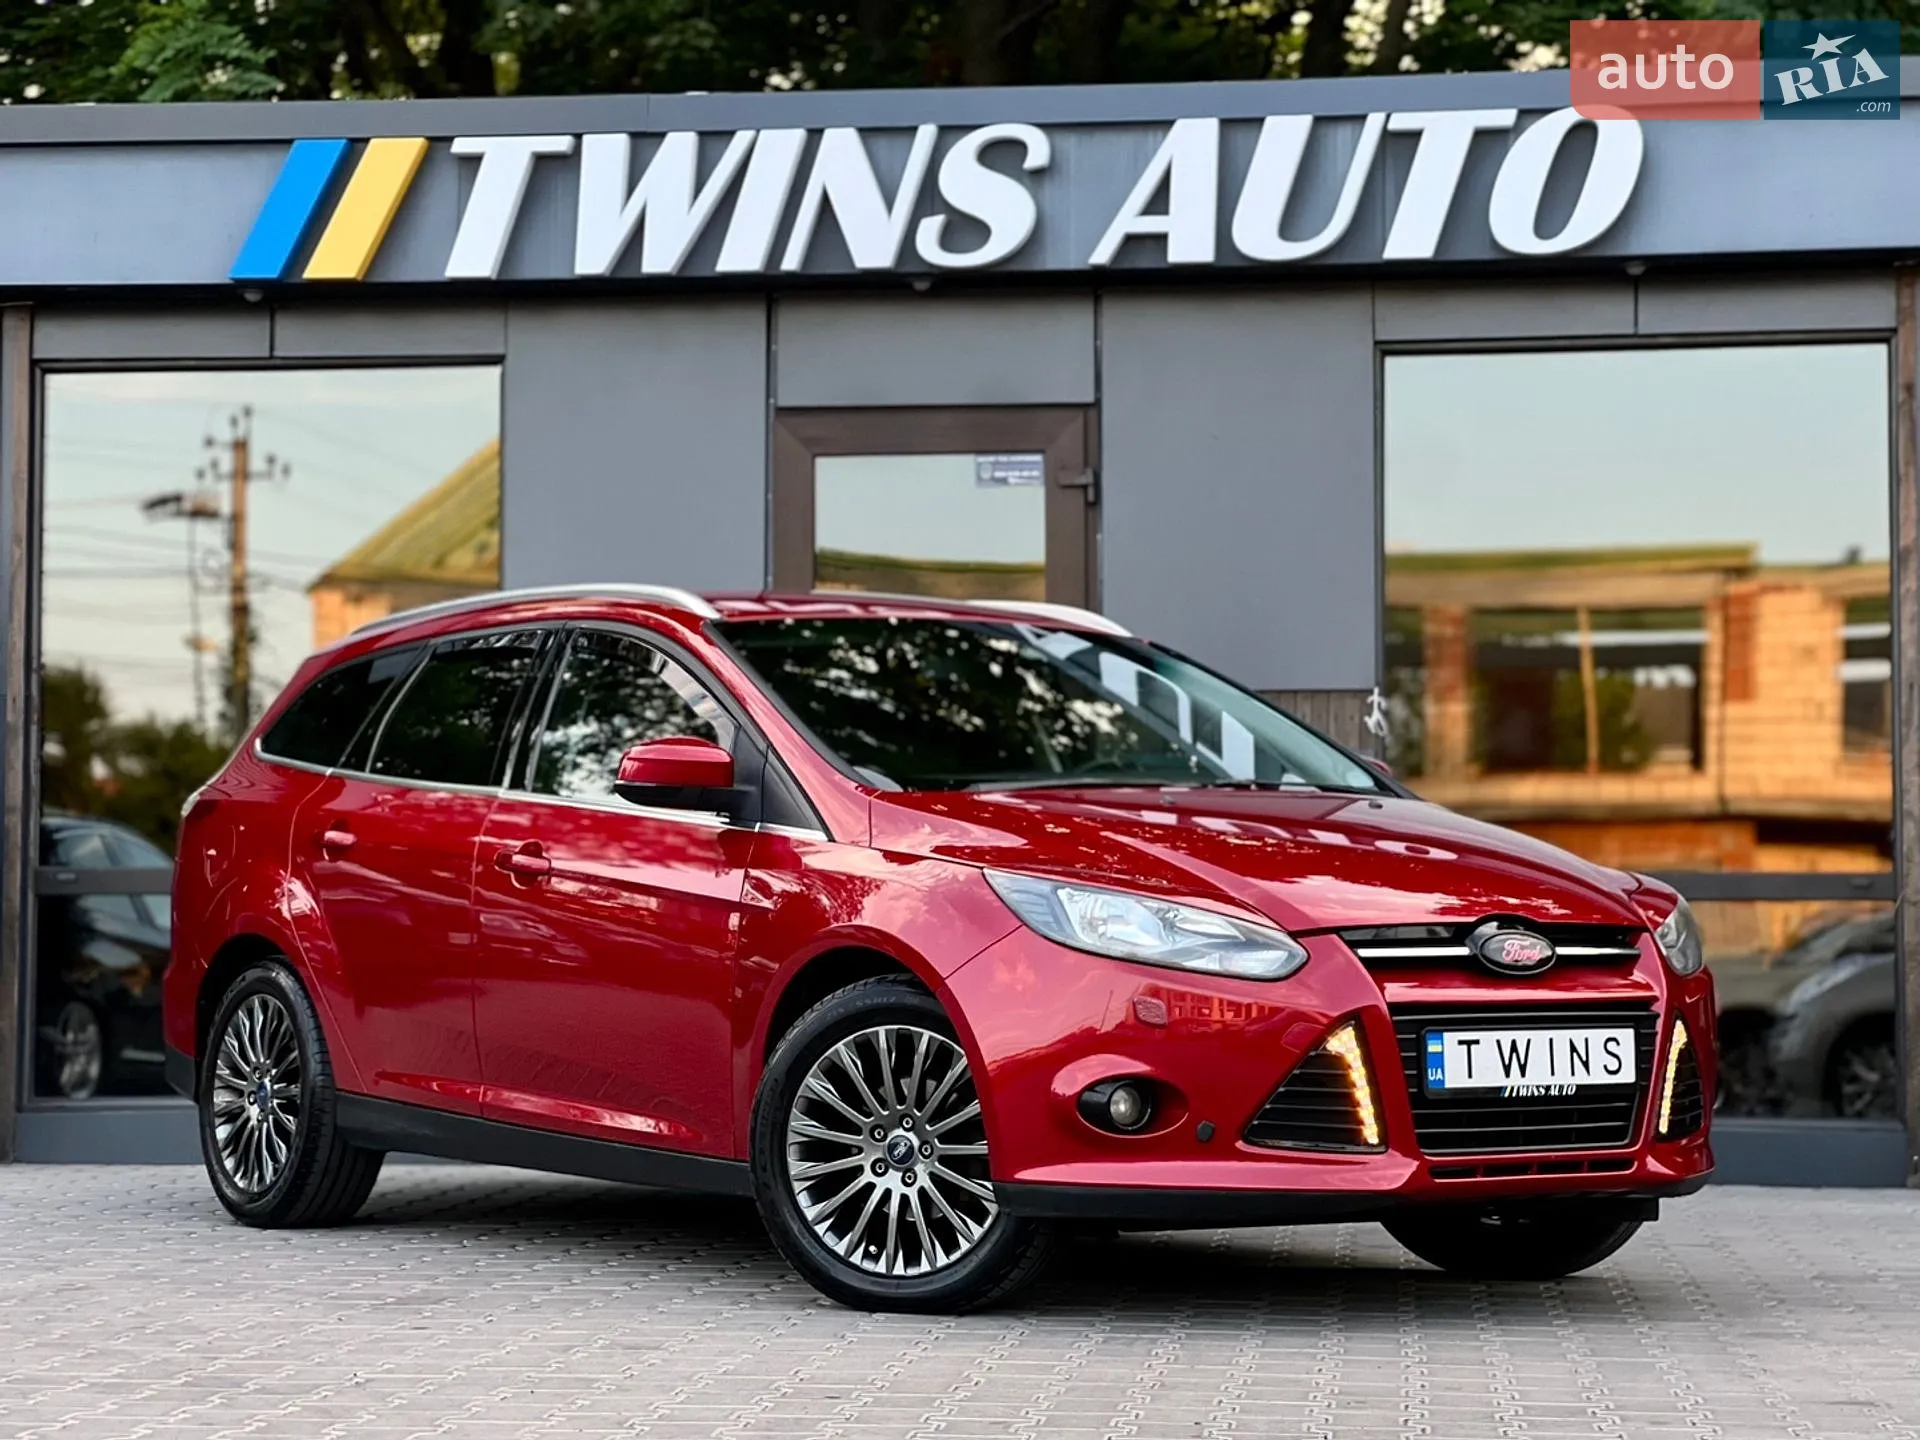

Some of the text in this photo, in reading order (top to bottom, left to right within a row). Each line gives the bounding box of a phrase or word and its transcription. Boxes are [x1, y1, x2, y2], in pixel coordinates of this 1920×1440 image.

[444, 104, 1644, 279] TWINS AUTO
[1502, 939, 1541, 962] Ford
[1428, 1068, 1443, 1081] UA
[1512, 1084, 1576, 1097] TWINS AUTO
